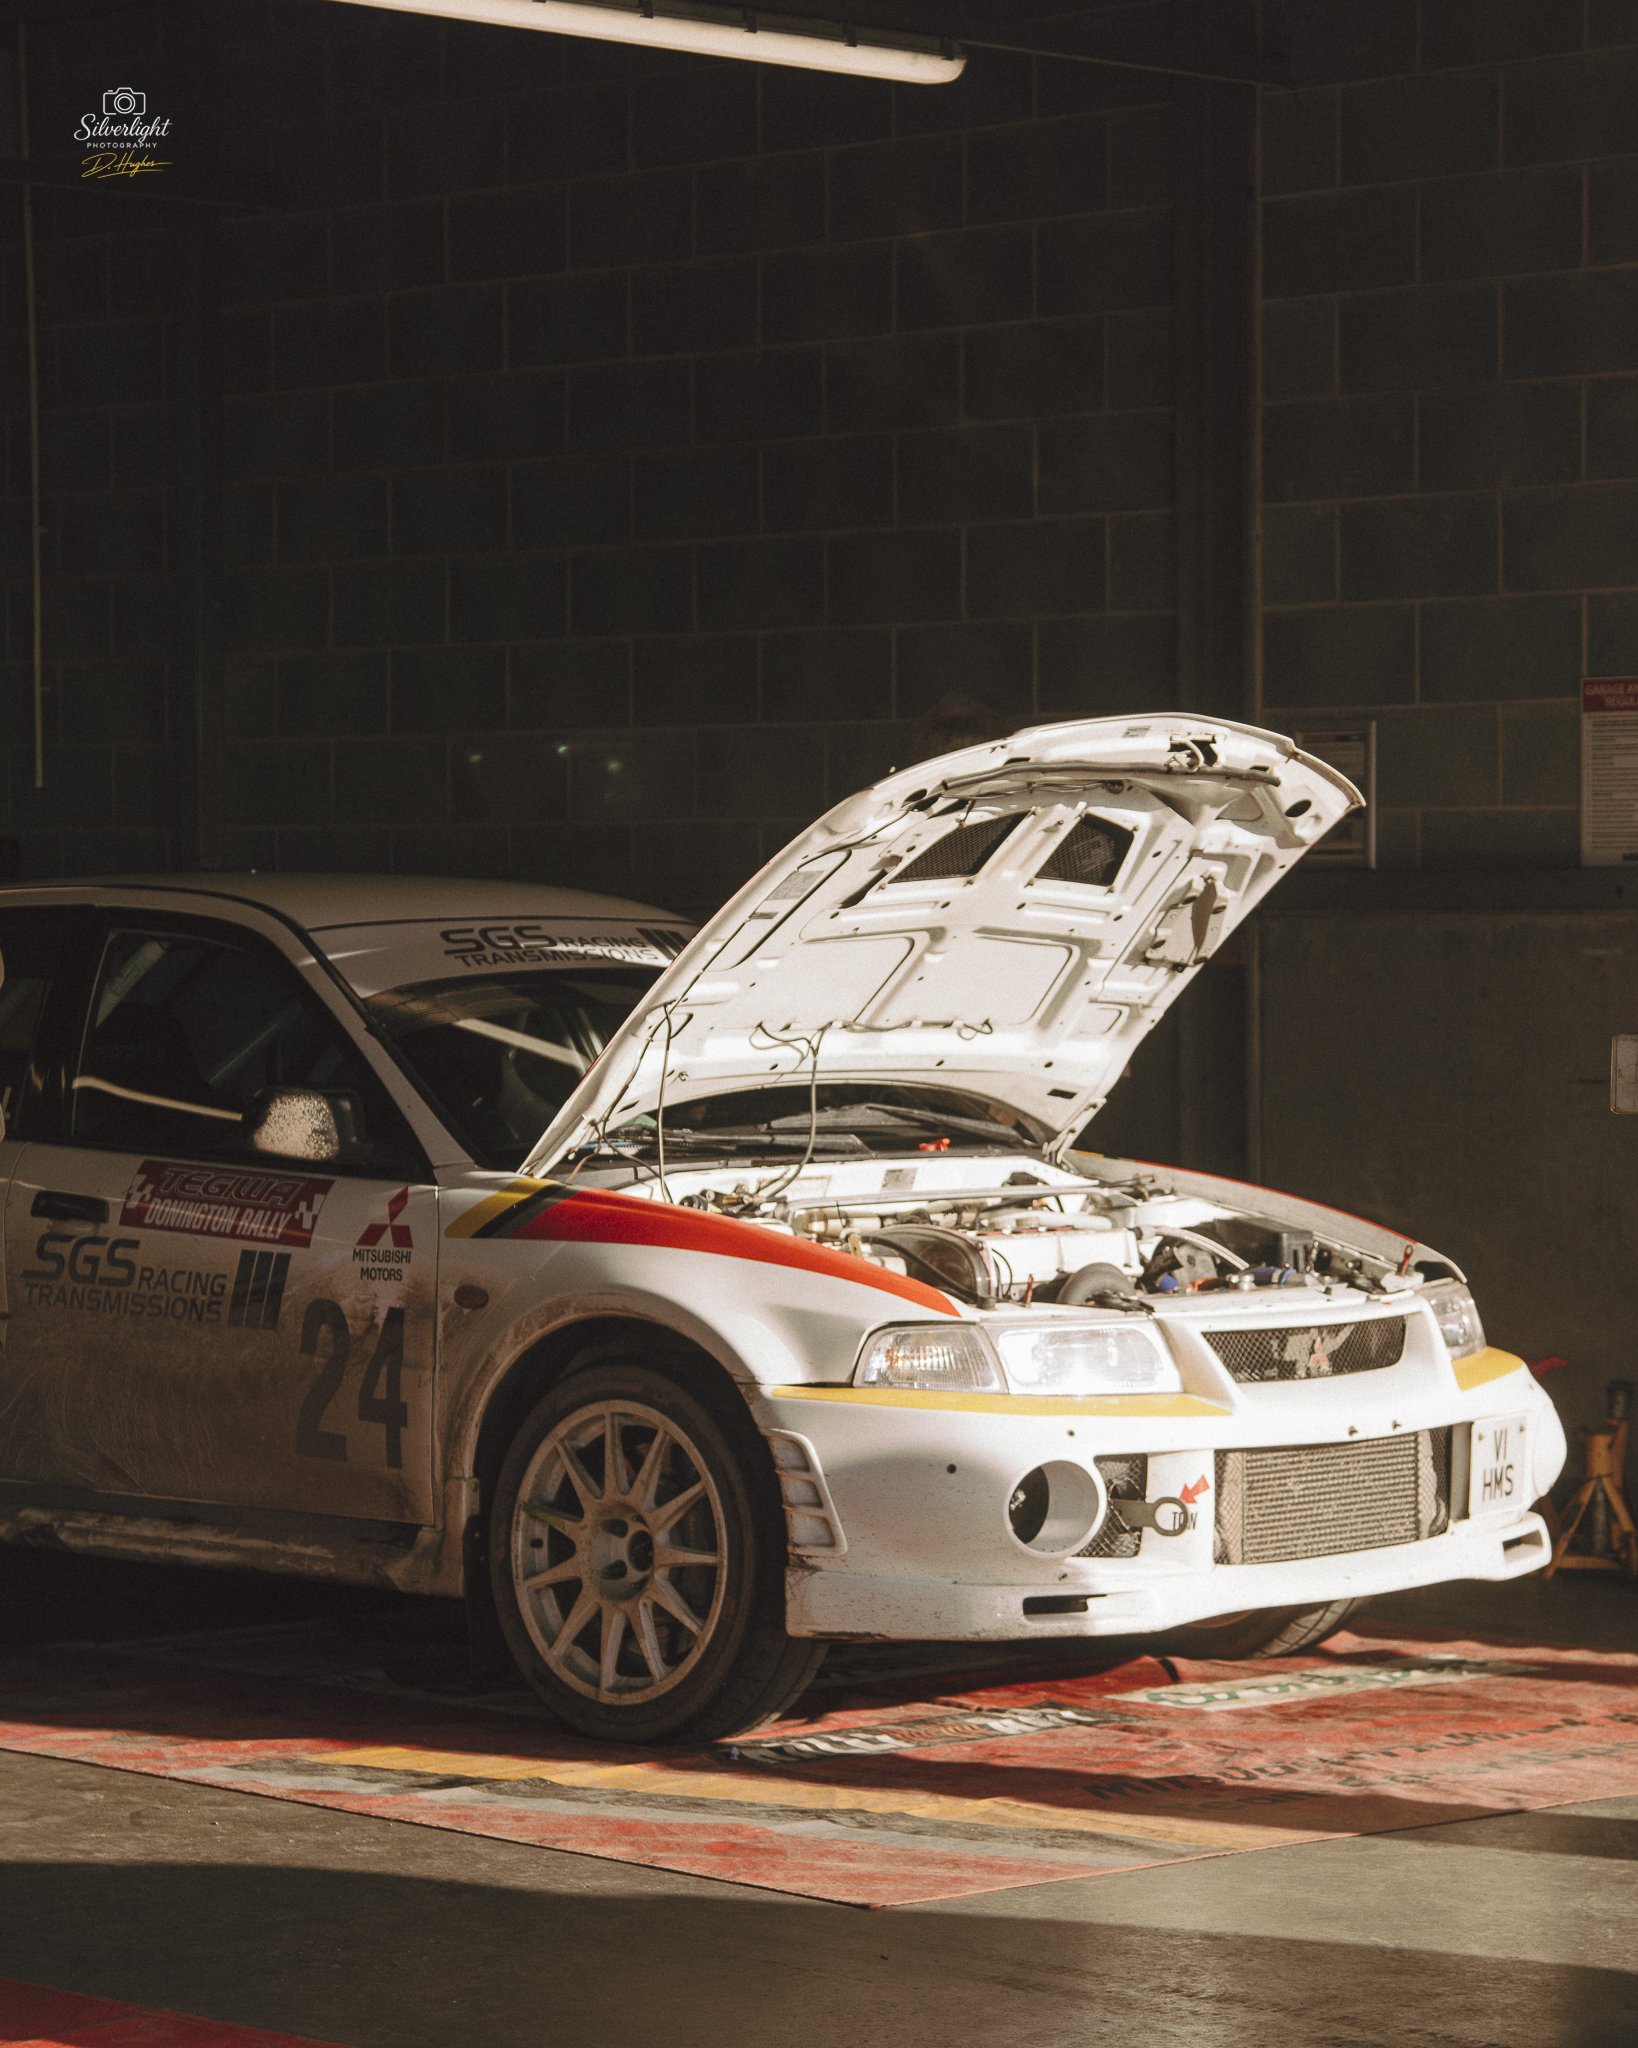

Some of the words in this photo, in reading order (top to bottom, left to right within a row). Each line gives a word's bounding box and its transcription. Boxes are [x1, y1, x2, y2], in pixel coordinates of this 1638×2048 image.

[439, 925, 557, 955] SGS
[558, 936, 646, 948] RACING
[454, 949, 659, 967] TRANSMISSIONS
[144, 1198, 240, 1234] DONINGTON
[236, 1208, 293, 1240] RALLY
[20, 1231, 141, 1287] SGS
[137, 1266, 228, 1297] RACING
[352, 1248, 411, 1264] MITSUBISHI
[360, 1267, 403, 1282] MOTORS
[24, 1282, 223, 1323] TRANSMISSIONS
[296, 1298, 408, 1470] 24
[1482, 1464, 1514, 1502] HMS
